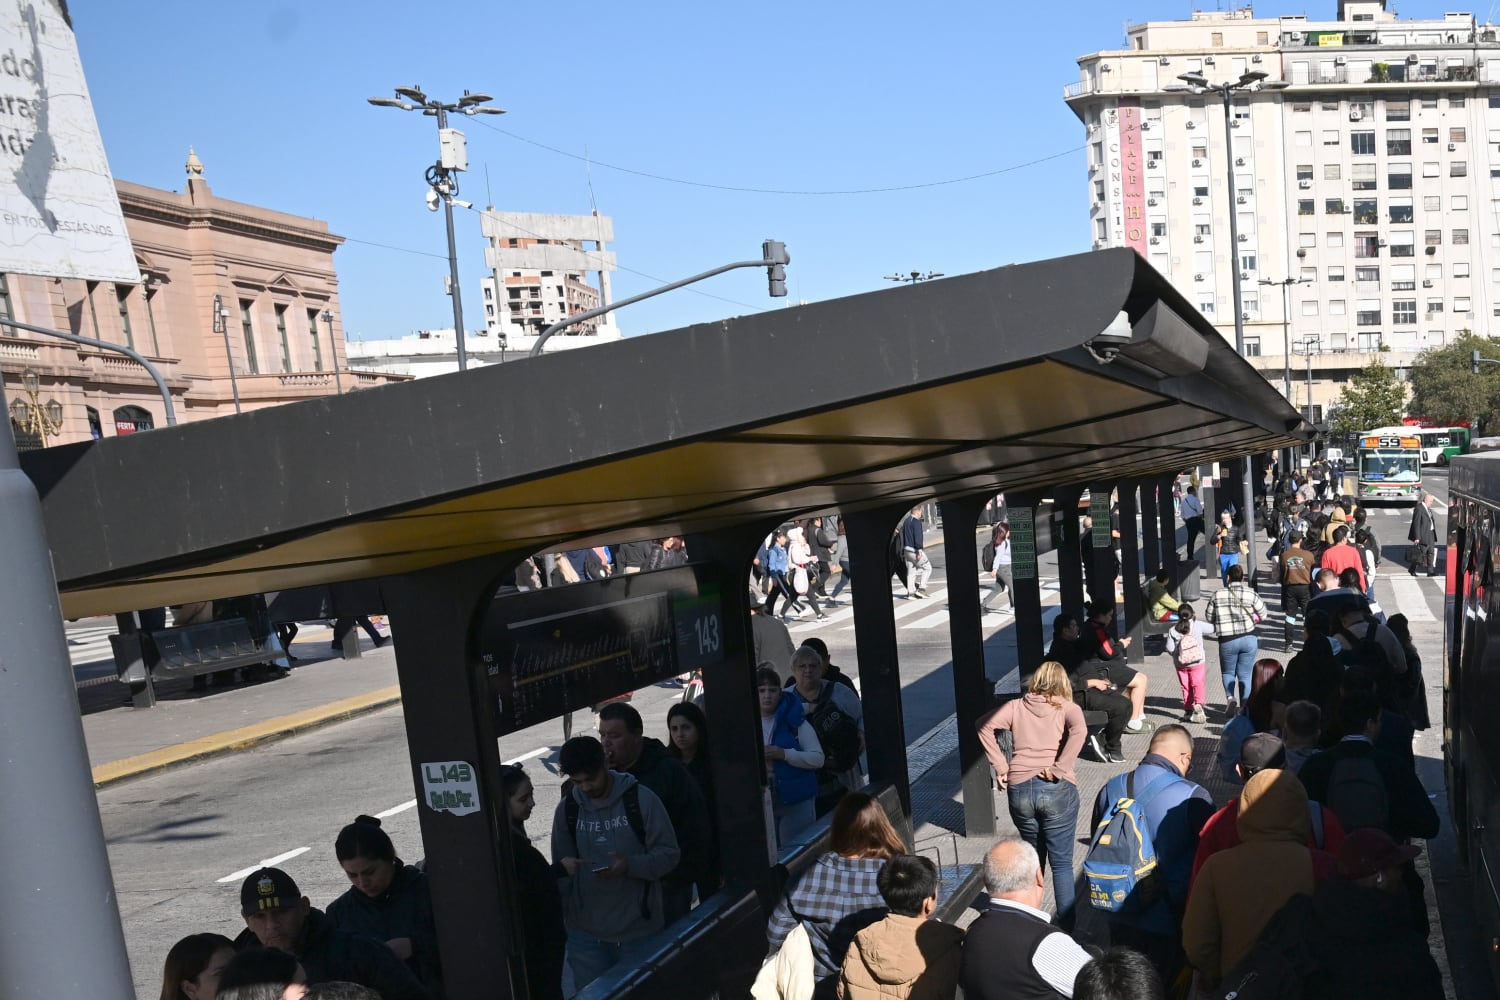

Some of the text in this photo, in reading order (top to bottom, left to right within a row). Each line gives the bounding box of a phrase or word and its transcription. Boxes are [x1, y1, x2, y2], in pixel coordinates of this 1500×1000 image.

[1110, 143, 1124, 249] CONSTIT
[1380, 438, 1401, 448] 59
[695, 613, 720, 656] 143
